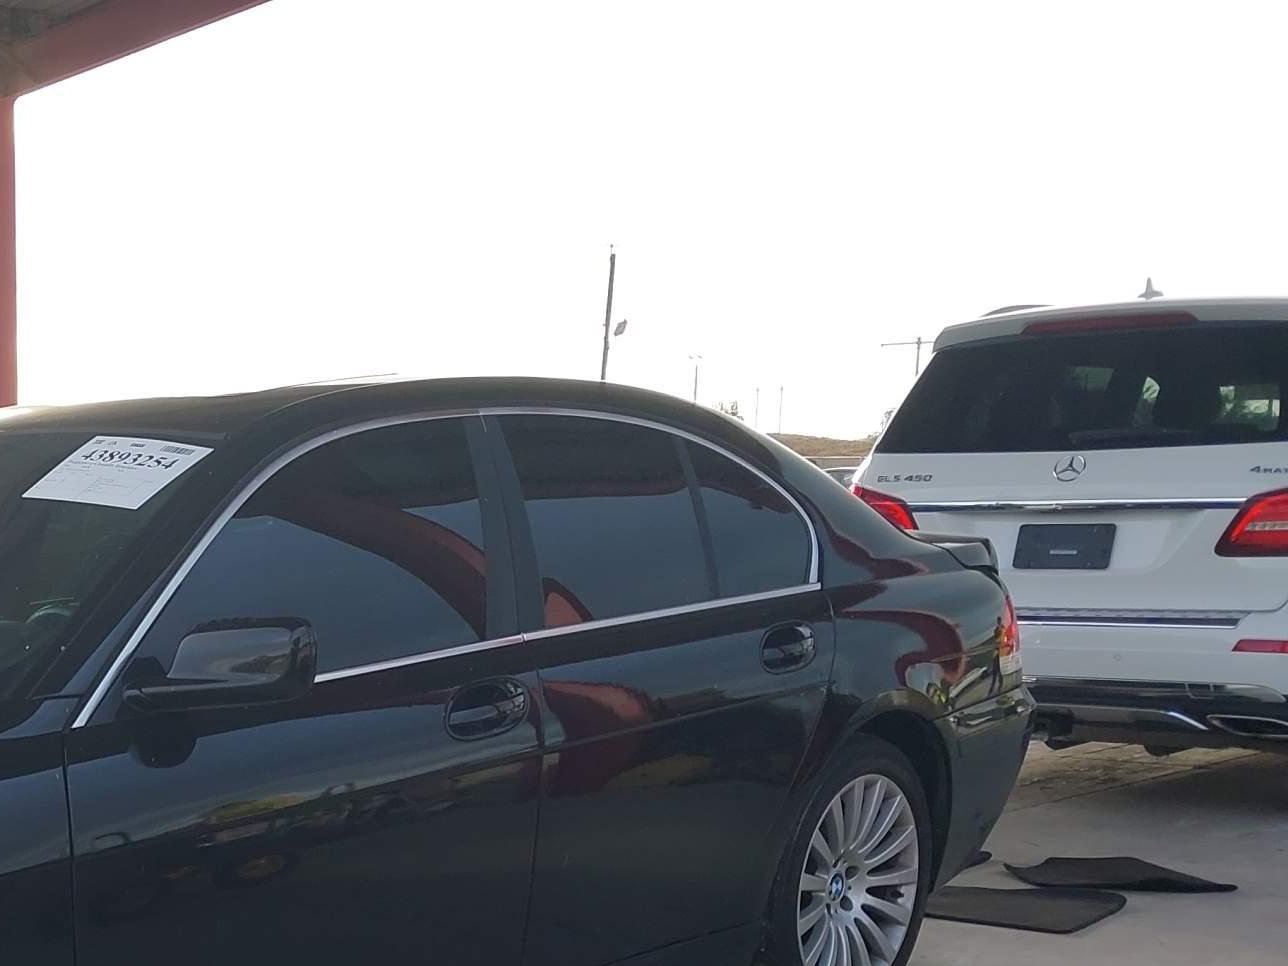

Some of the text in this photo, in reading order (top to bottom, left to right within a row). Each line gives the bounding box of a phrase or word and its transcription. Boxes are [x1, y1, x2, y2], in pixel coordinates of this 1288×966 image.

[81, 448, 180, 469] 43893254
[877, 474, 933, 483] GLS 450
